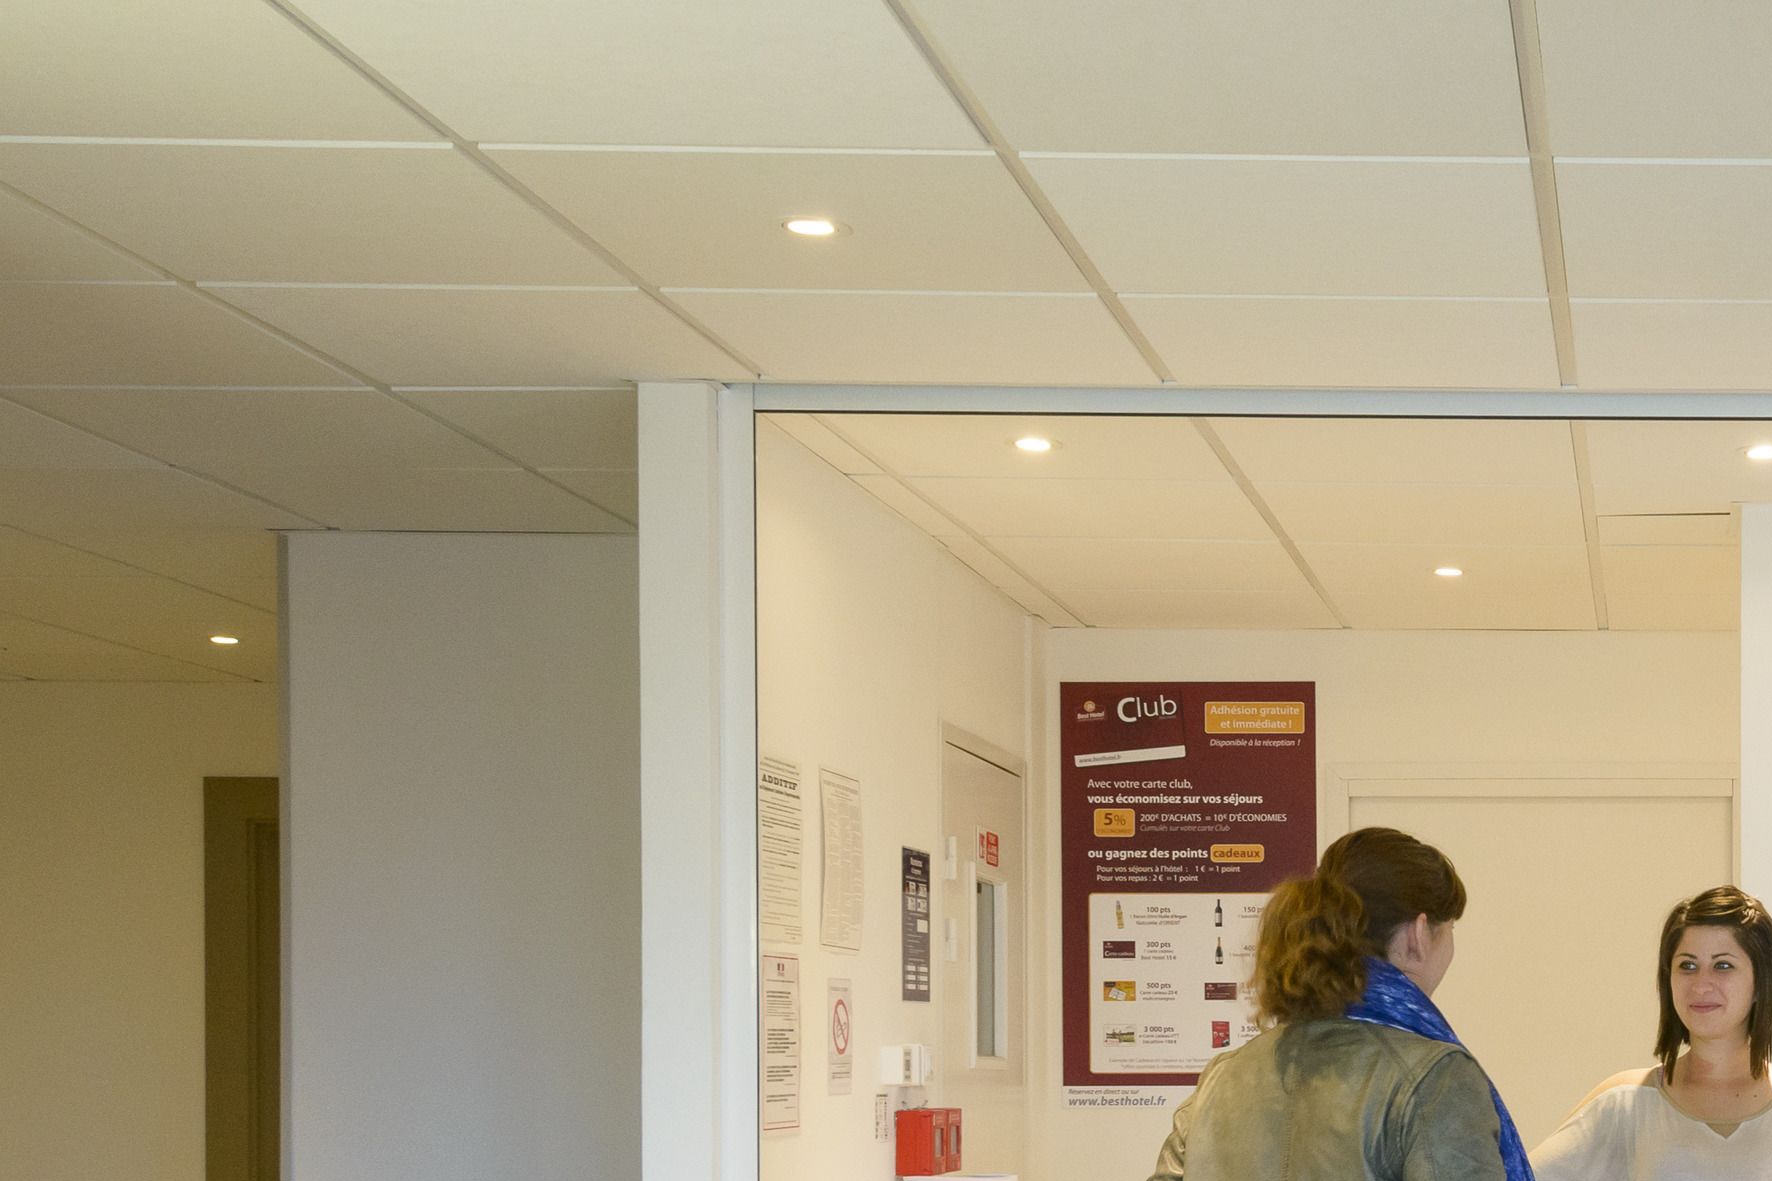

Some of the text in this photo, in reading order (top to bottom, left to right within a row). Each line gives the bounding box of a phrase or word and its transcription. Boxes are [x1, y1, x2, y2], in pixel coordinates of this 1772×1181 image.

[1117, 694, 1178, 723] Club
[1210, 704, 1300, 718] Adhésion gratuite
[1220, 720, 1230, 730] et
[1233, 719, 1287, 730] immédiate
[1209, 738, 1248, 749] Disponible
[1254, 738, 1262, 747] la
[1262, 738, 1297, 749] réception
[1087, 778, 1193, 790] Avec votre carte club,
[1087, 793, 1263, 806] vous économisez sur vos séjours
[1103, 812, 1126, 826] 5%
[1140, 813, 1159, 822] 200€
[1161, 812, 1202, 822] D'ACHATS
[1213, 813, 1227, 822] 10€
[1229, 811, 1288, 823] D'ÉCONOMIES
[1088, 848, 1261, 861] ou gagnez des points cadeaux
[1096, 865, 1114, 874] Pour
[1114, 866, 1127, 874] vos
[1127, 864, 1154, 875] séjours
[1160, 864, 1184, 874] l'hôtel
[1221, 864, 1241, 876] point
[1096, 874, 1114, 883] Pour
[1114, 875, 1128, 883] vos
[1128, 874, 1148, 885] repas
[1178, 873, 1199, 885] point
[1160, 906, 1171, 916] pts
[1160, 941, 1171, 951] pts
[1160, 982, 1171, 992] pts
[1163, 1026, 1175, 1035] pts
[1068, 1095, 1167, 1107] www.besthotel.fr
